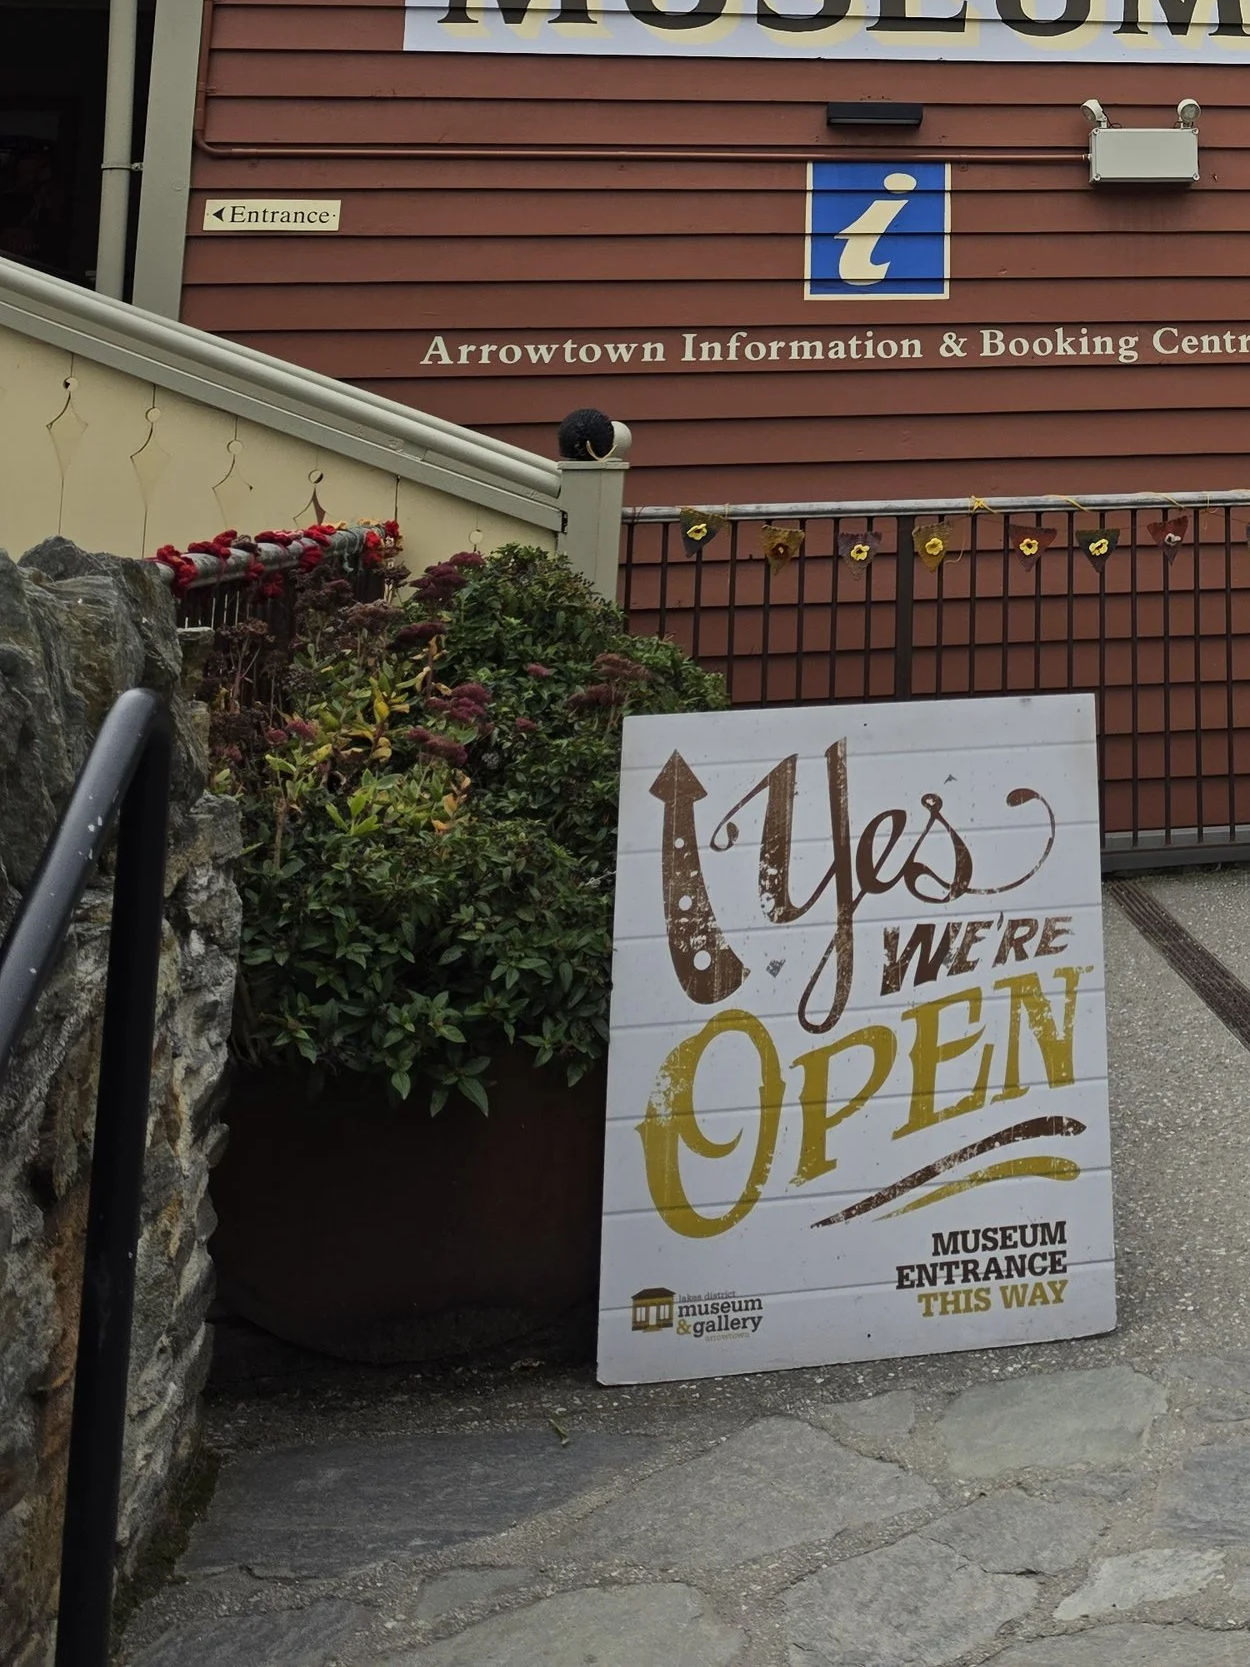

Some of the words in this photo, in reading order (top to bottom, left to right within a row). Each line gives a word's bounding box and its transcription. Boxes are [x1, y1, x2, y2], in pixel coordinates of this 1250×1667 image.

[229, 205, 330, 224] Entrance
[419, 335, 667, 366] Arrowtown
[680, 330, 923, 362] Information
[938, 331, 968, 358] &
[979, 327, 1139, 364] Booking
[709, 736, 1056, 1034] Yes
[880, 911, 1075, 997] WE'RE
[634, 964, 1094, 1239] OPEN
[931, 1220, 1068, 1257] MUSEUM
[895, 1249, 1068, 1291] ENTRANCE
[677, 1297, 764, 1318] museum
[678, 1293, 701, 1303] lakes
[704, 1290, 736, 1301] district
[917, 1286, 993, 1318] THIS
[999, 1279, 1069, 1310] WAY
